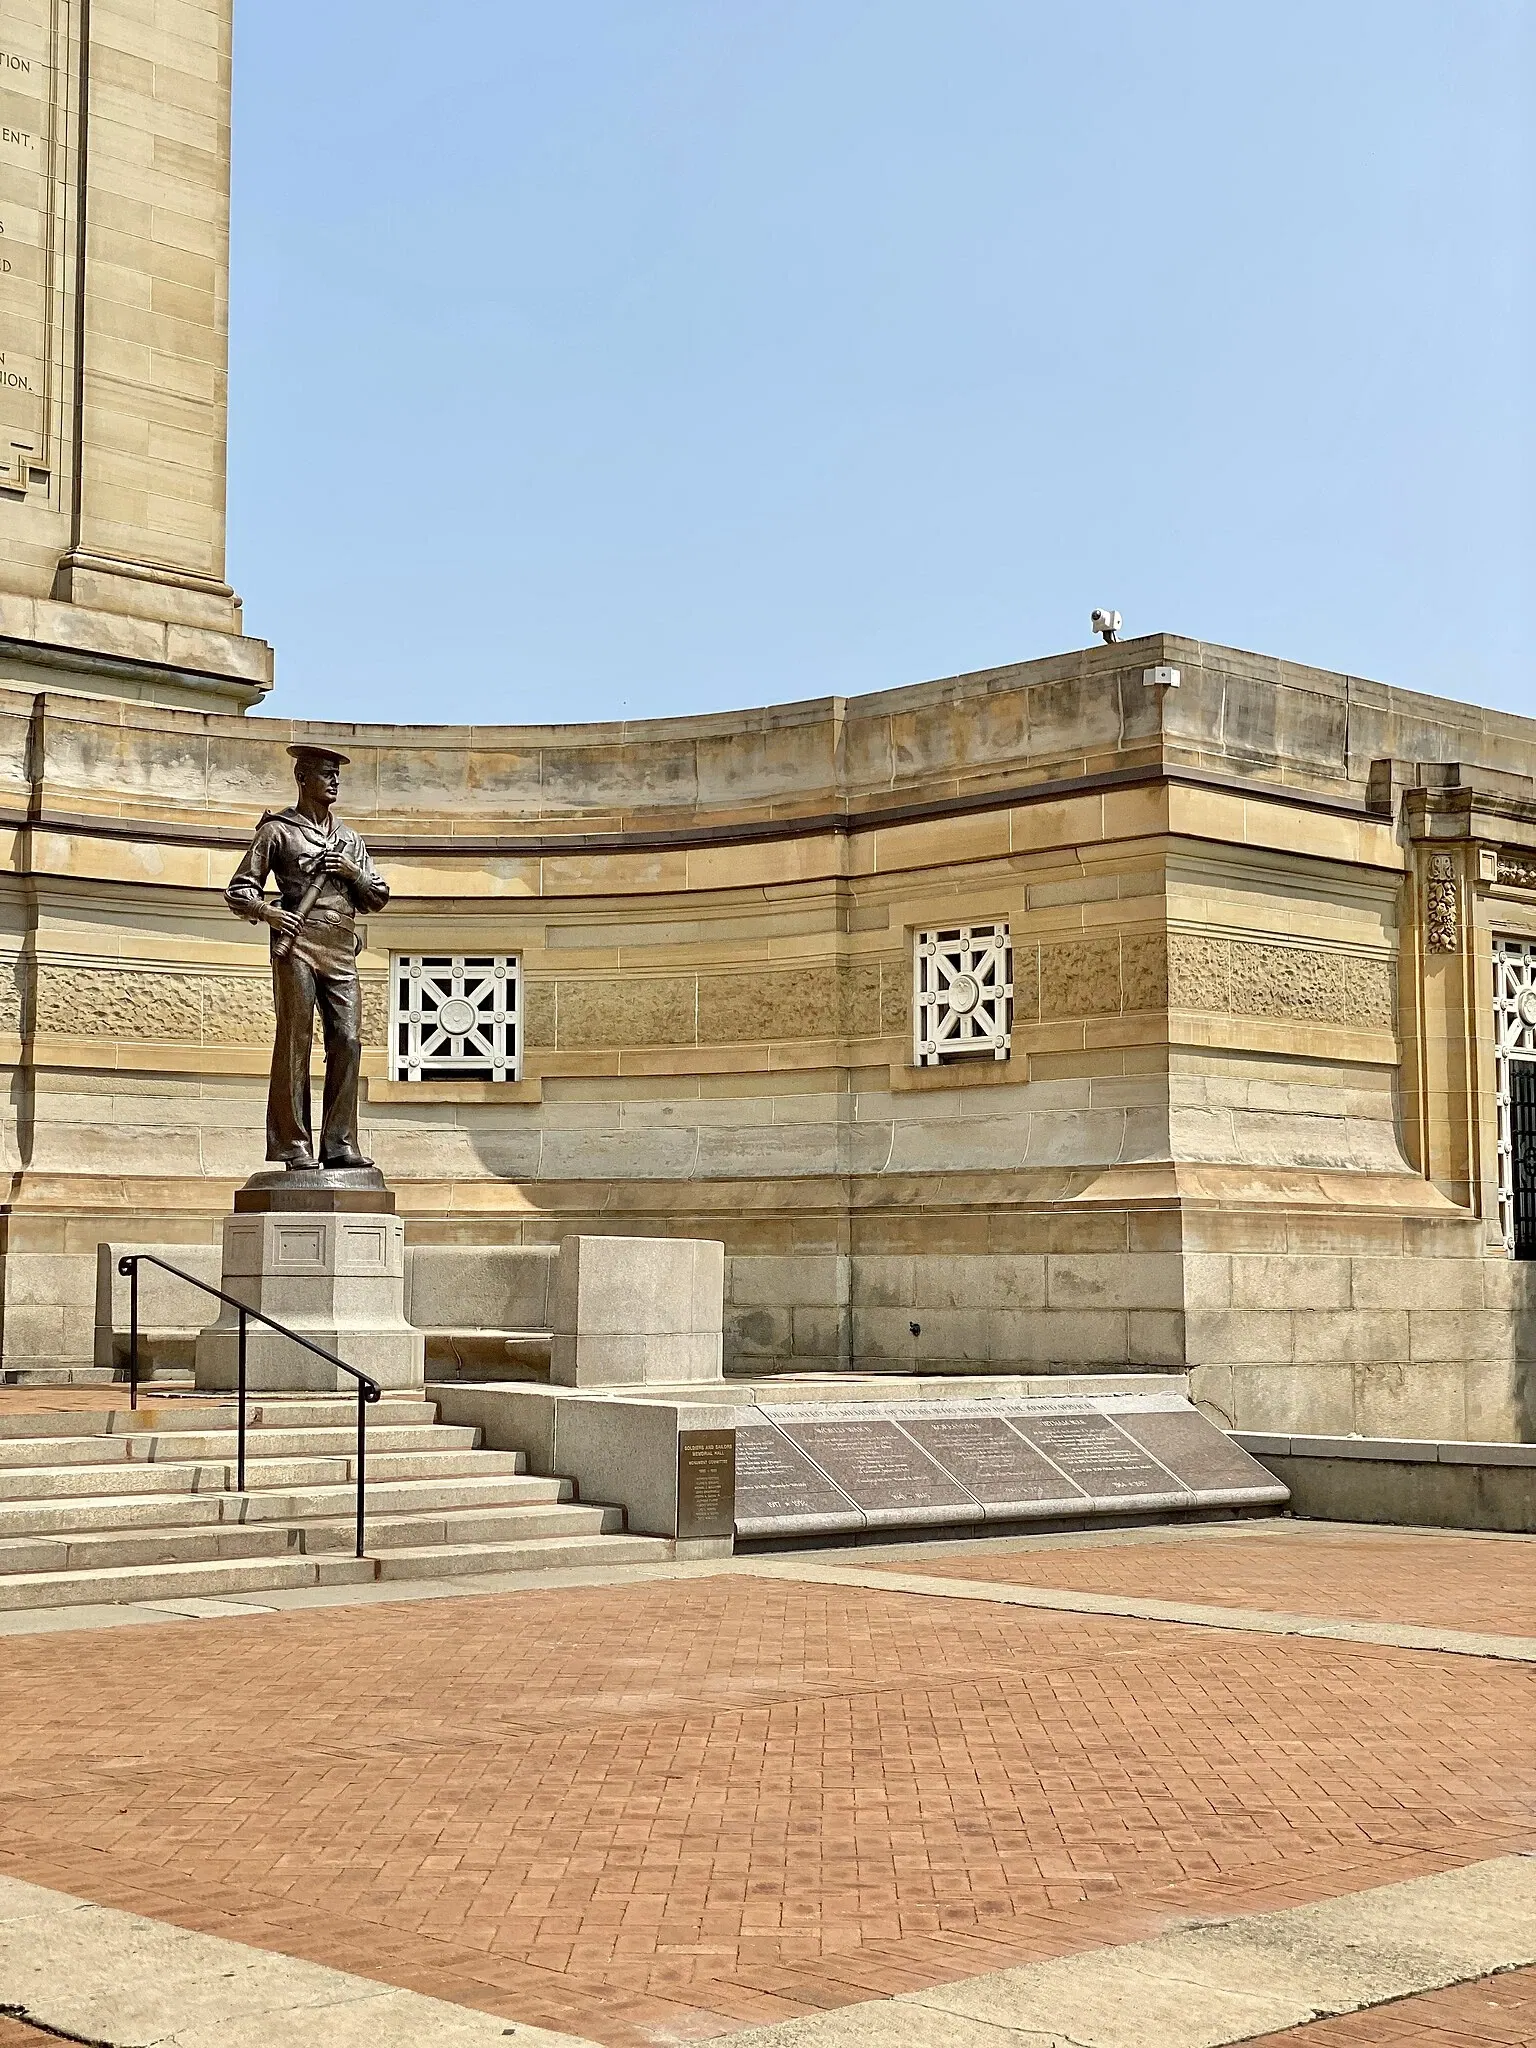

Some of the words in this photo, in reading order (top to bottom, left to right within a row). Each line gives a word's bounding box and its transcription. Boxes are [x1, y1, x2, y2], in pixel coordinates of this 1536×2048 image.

[2, 127, 34, 150] ENT,
[767, 1409, 823, 1419] DEDICATED
[839, 1409, 880, 1418] MEMORY
[884, 1408, 899, 1416] OF
[900, 1407, 930, 1416] THOSE
[931, 1406, 957, 1415] WHO
[957, 1405, 992, 1414] SERVED
[992, 1405, 1005, 1413] IN
[1026, 1403, 1057, 1412] ARMED
[814, 1426, 845, 1434] WORLD
